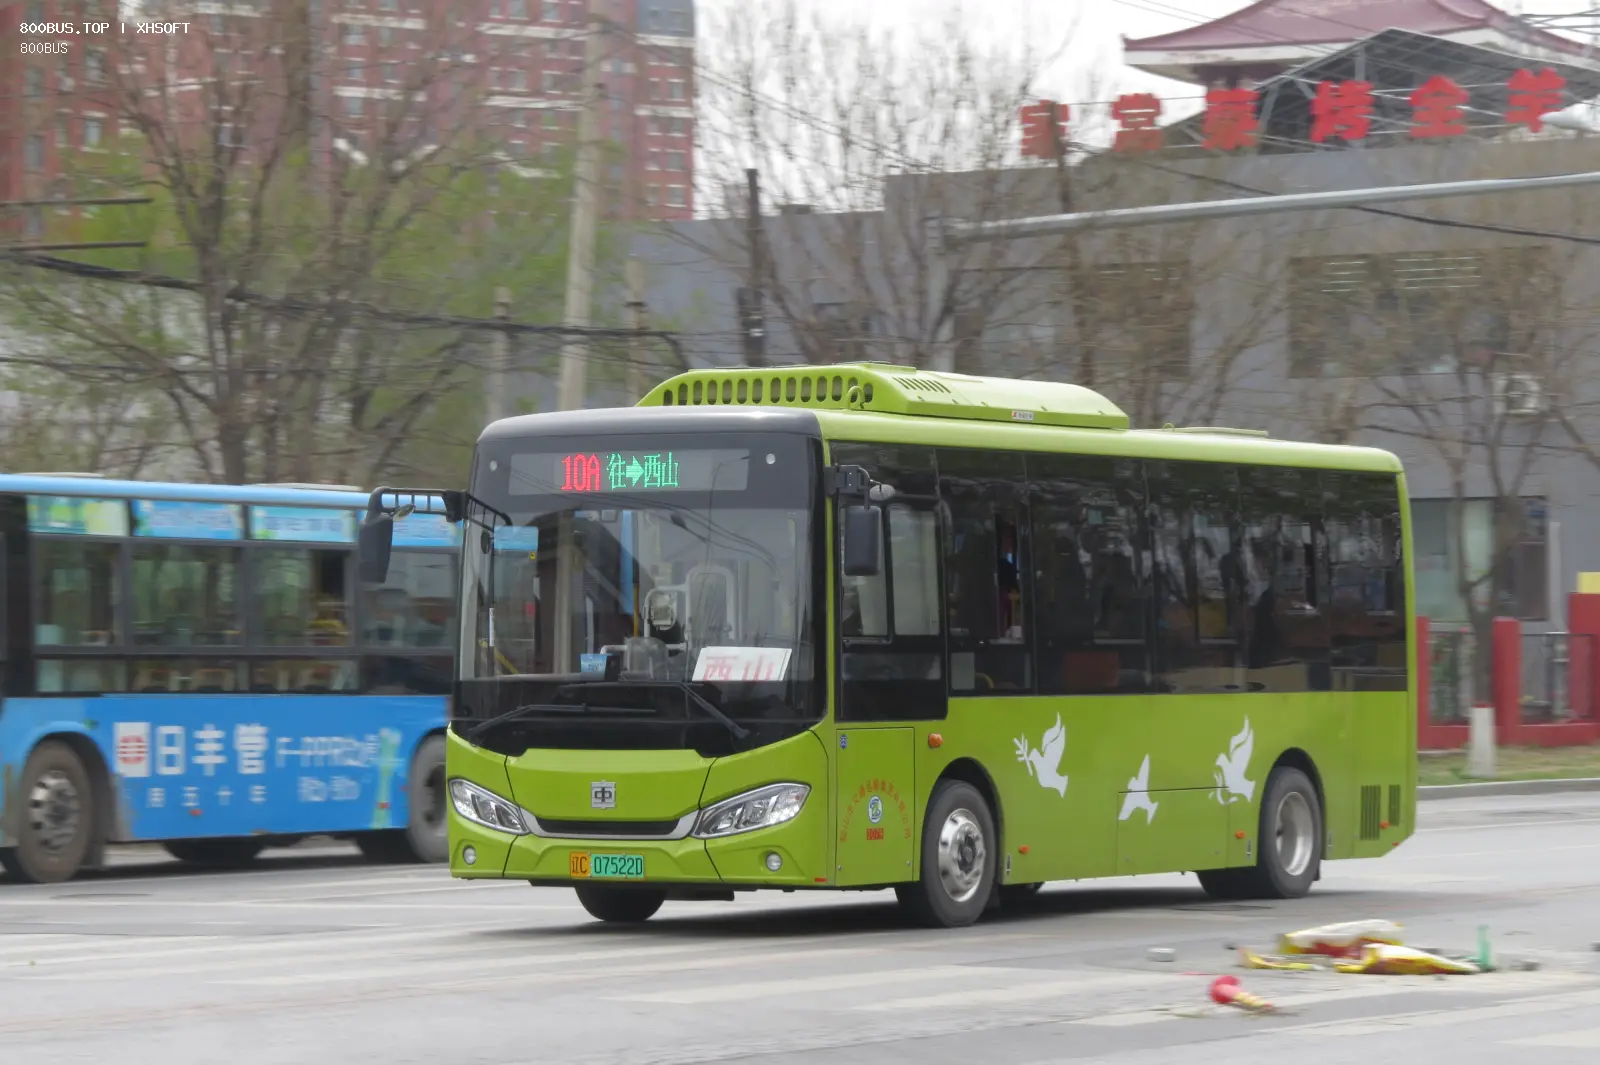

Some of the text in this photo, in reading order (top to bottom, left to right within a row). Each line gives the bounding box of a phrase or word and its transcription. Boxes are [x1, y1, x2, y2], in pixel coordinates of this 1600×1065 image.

[561, 453, 600, 491] 10A
[703, 655, 775, 681] 西山
[593, 856, 643, 876] 07522D
